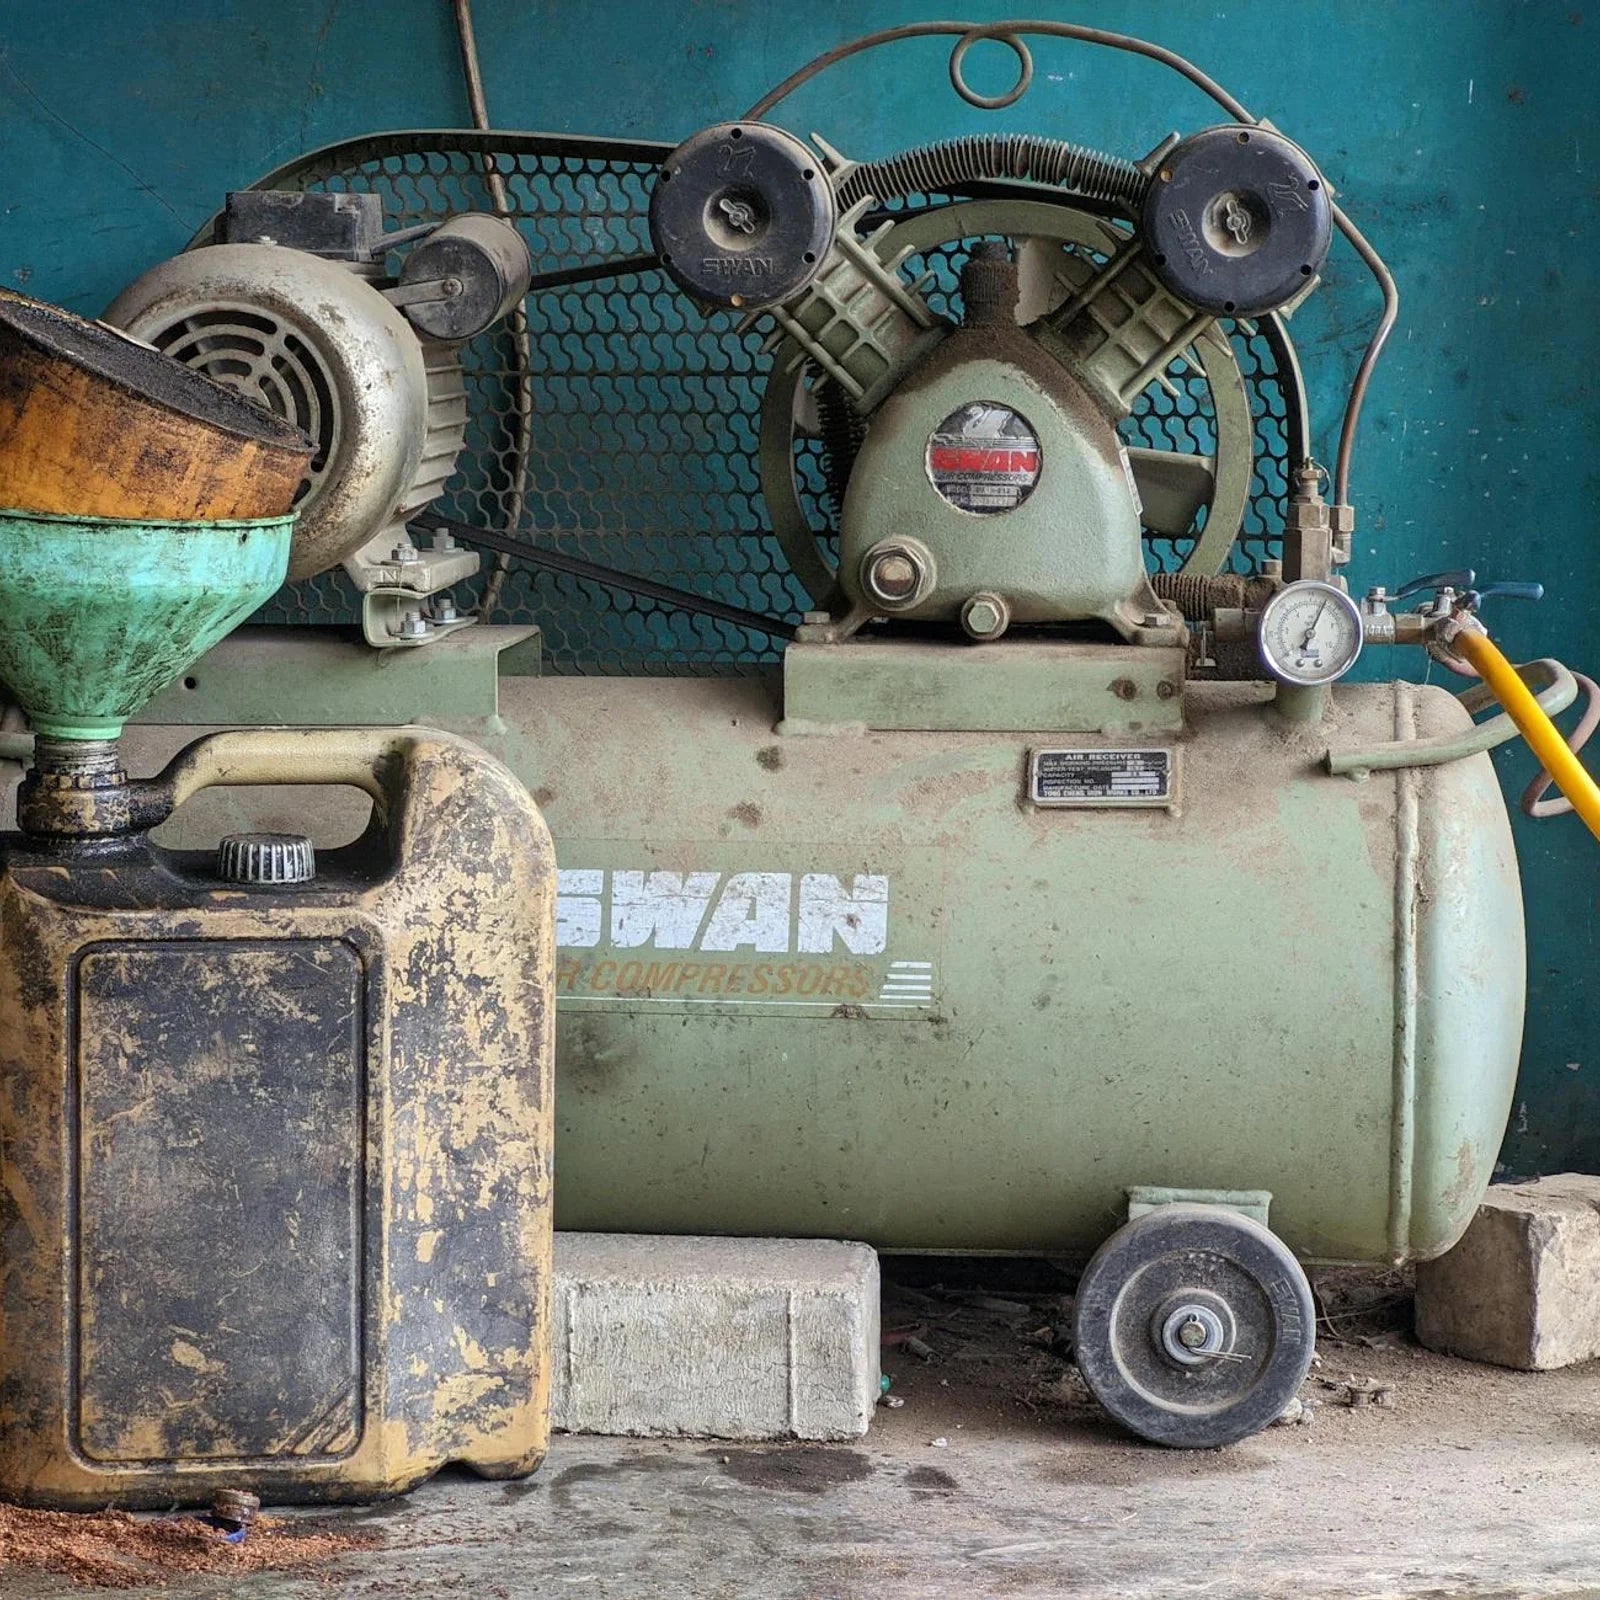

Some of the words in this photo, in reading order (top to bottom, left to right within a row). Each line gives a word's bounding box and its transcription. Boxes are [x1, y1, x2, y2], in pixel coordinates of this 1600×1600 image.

[702, 257, 773, 276] SWAN
[1169, 208, 1214, 276] SWAN
[556, 869, 889, 955] SWAN
[591, 960, 872, 999] COMPRESSORS
[1270, 1276, 1302, 1346] SWAN
